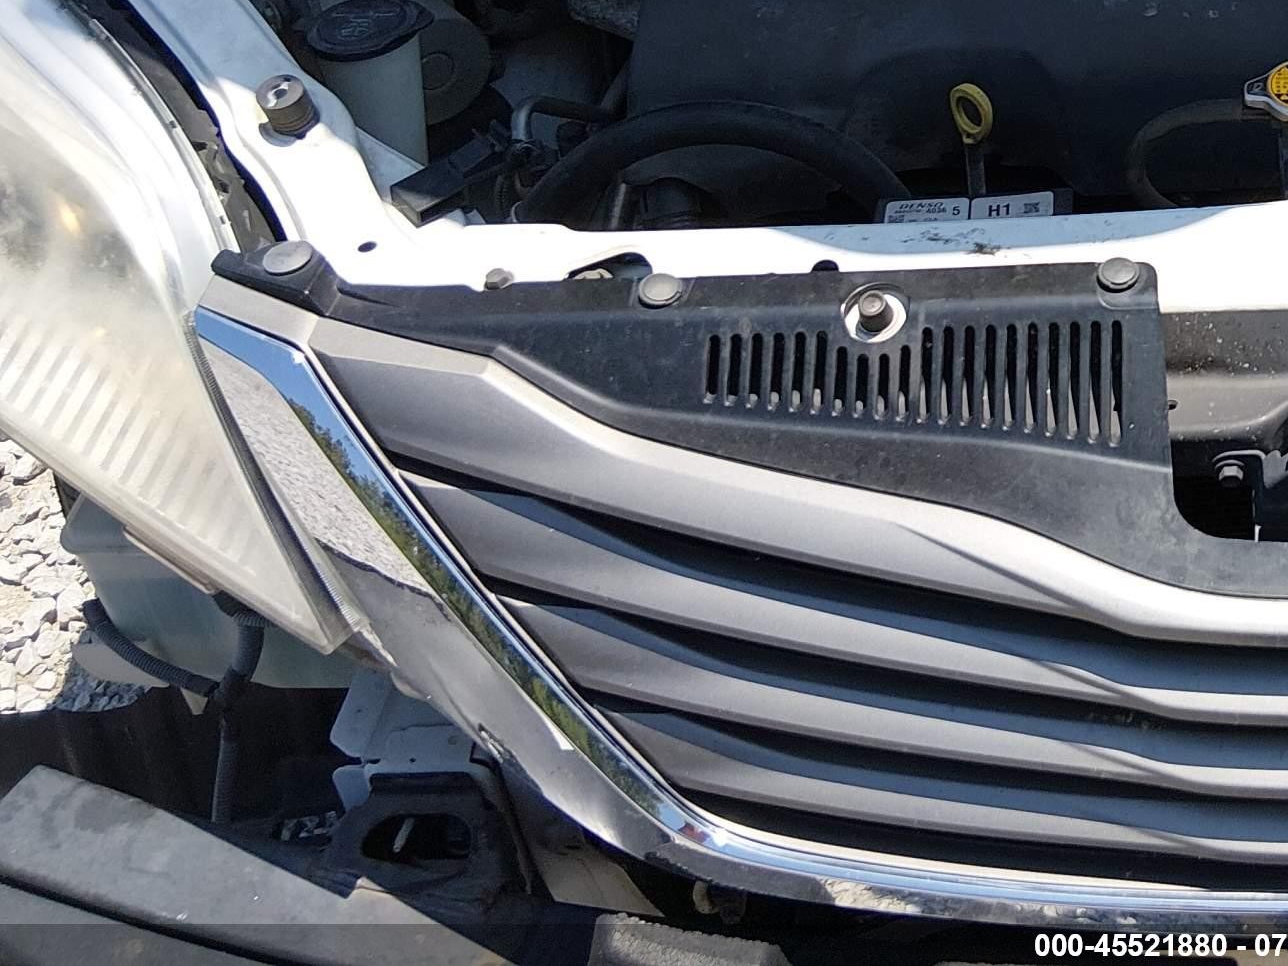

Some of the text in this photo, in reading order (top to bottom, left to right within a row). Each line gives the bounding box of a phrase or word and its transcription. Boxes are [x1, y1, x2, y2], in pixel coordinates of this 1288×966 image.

[898, 201, 944, 210] DENSO
[952, 202, 1011, 217] 5 H1
